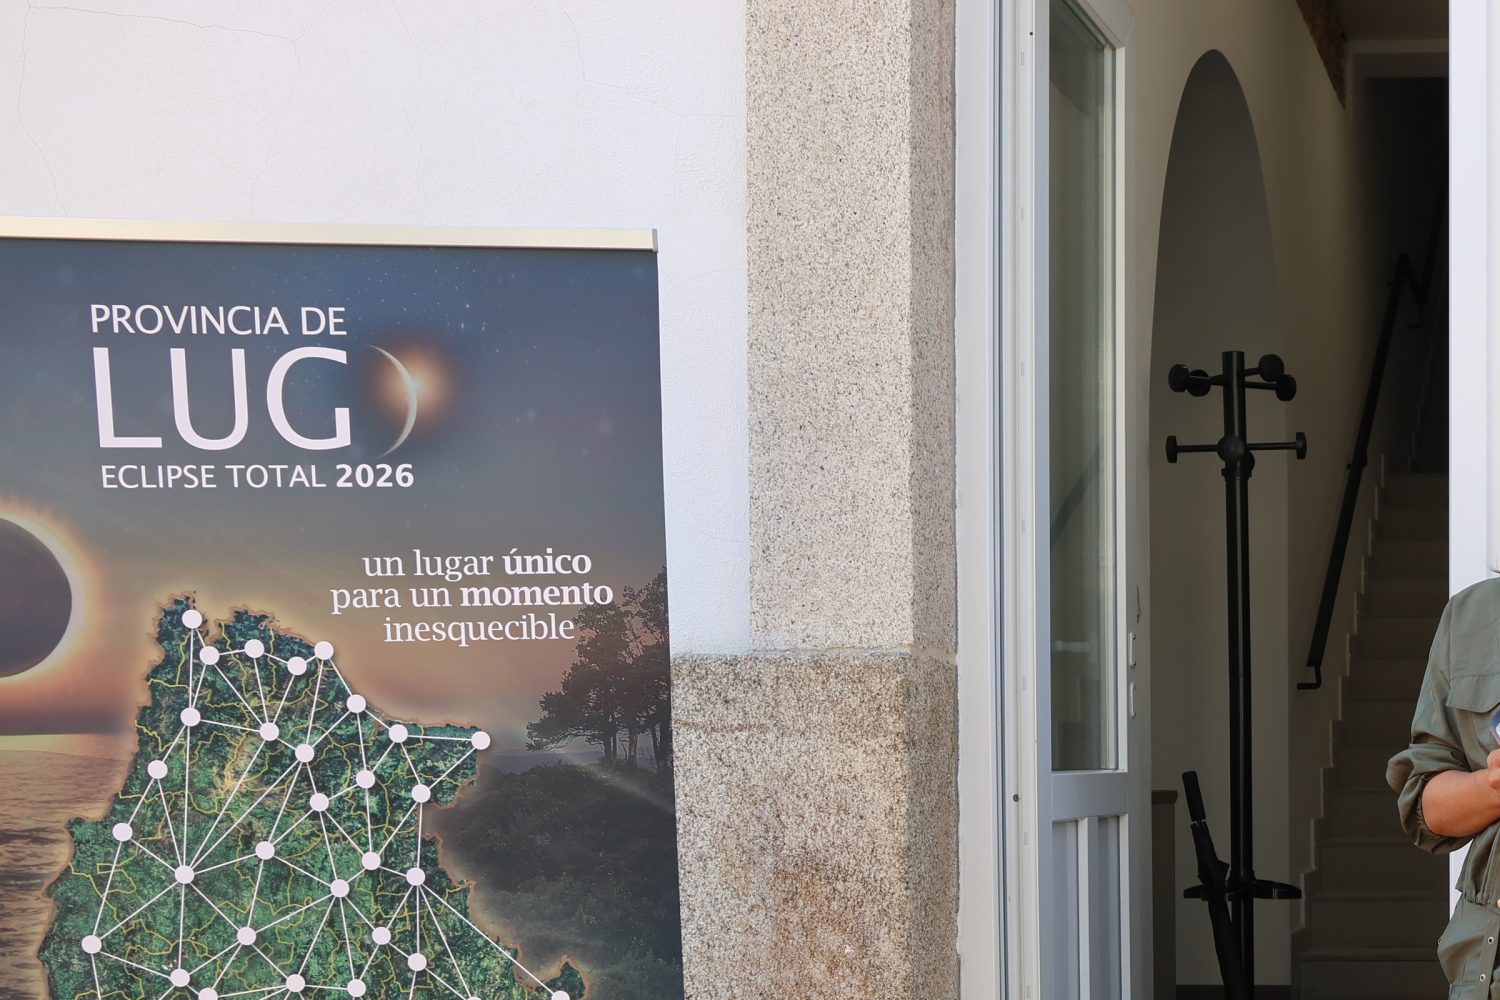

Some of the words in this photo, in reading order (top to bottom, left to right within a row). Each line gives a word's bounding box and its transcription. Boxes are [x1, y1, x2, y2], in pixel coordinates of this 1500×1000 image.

[91, 304, 289, 335] PROVINCIA
[301, 306, 347, 335] DE
[101, 465, 216, 489] ECLIPSE
[225, 464, 326, 488] TOTAL
[336, 463, 414, 488] 2026
[362, 556, 405, 577] un
[413, 549, 494, 582] lugar
[502, 547, 591, 575] único
[330, 587, 401, 615] para
[409, 587, 452, 607] un
[460, 582, 613, 607] momento
[383, 613, 575, 647] inesquecible
